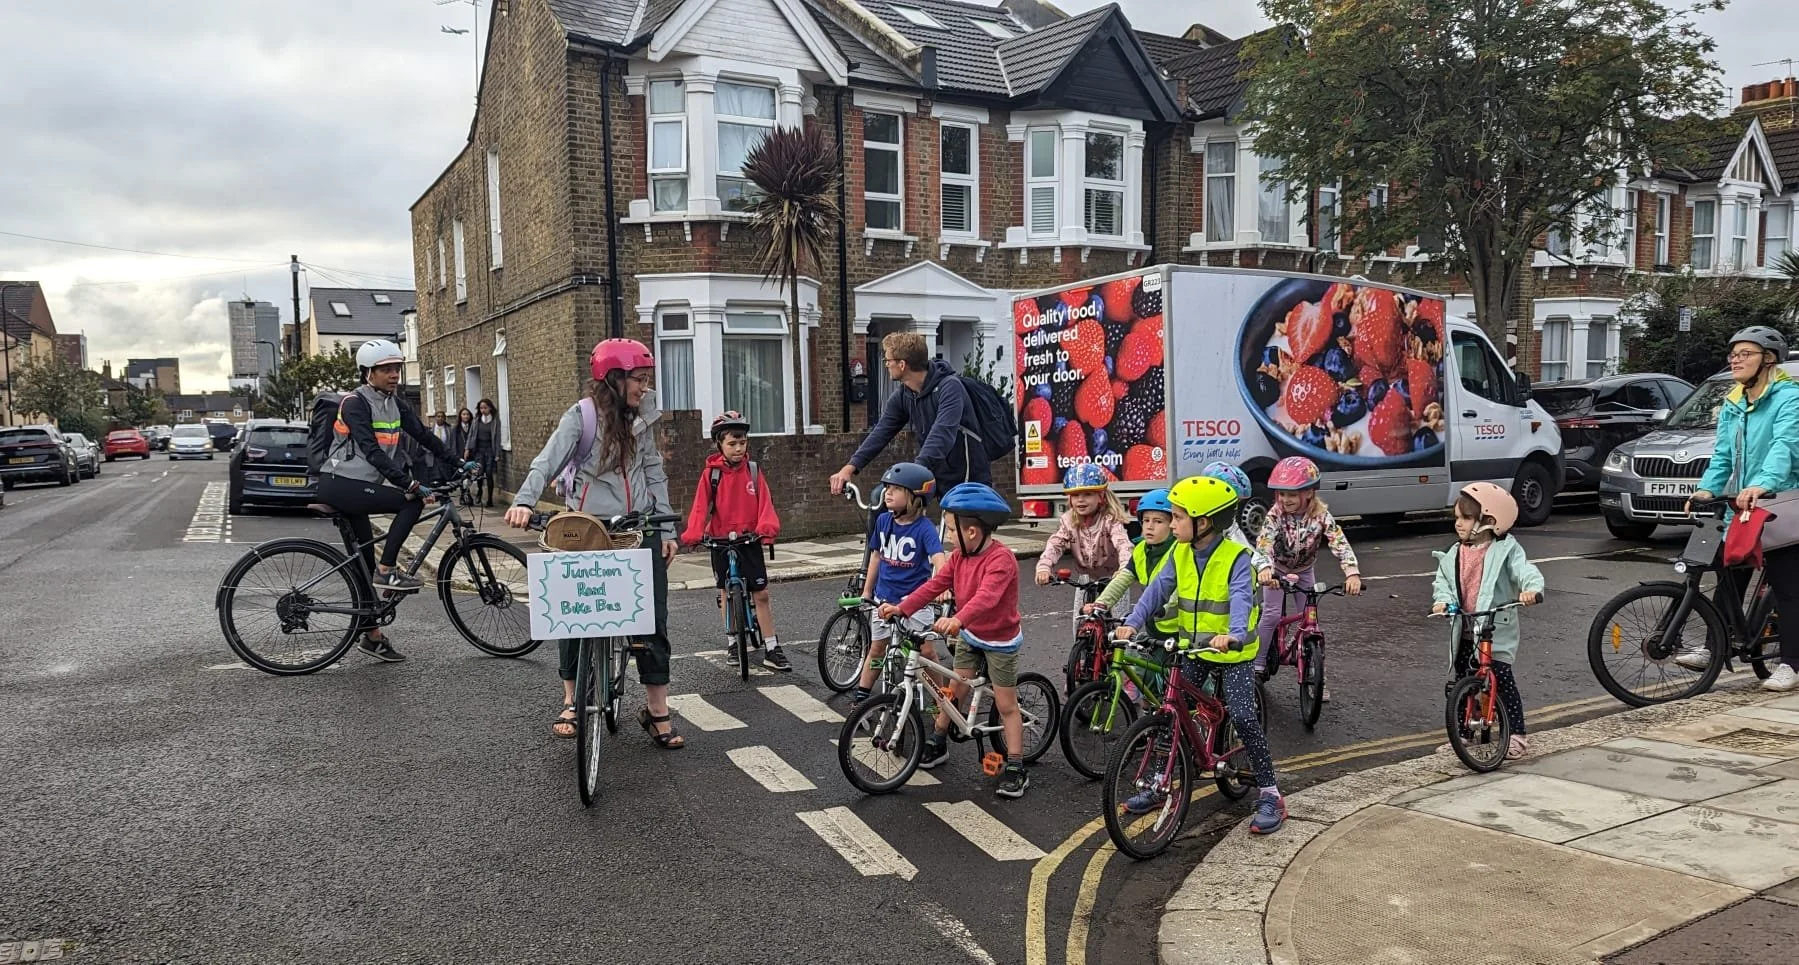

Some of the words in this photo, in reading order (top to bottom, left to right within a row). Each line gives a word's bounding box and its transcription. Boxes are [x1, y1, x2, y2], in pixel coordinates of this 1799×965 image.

[1022, 309, 1065, 328] Quality
[1065, 301, 1100, 321] food,
[1023, 326, 1079, 348] delivered
[1023, 351, 1054, 368] fresh
[1056, 350, 1070, 364] to
[1023, 373, 1051, 391] your
[1053, 368, 1085, 383] door.
[1182, 420, 1241, 437] TESCO
[1474, 425, 1505, 435] TESCO
[1057, 452, 1123, 469] tesco.com
[1182, 448, 1205, 463] Every
[1206, 447, 1224, 459] little
[1225, 447, 1242, 460] helps
[1651, 483, 1676, 494] FP17
[561, 561, 622, 579] Junction
[577, 582, 606, 597] Road
[560, 601, 592, 615] Bike
[595, 600, 622, 613] Bus
